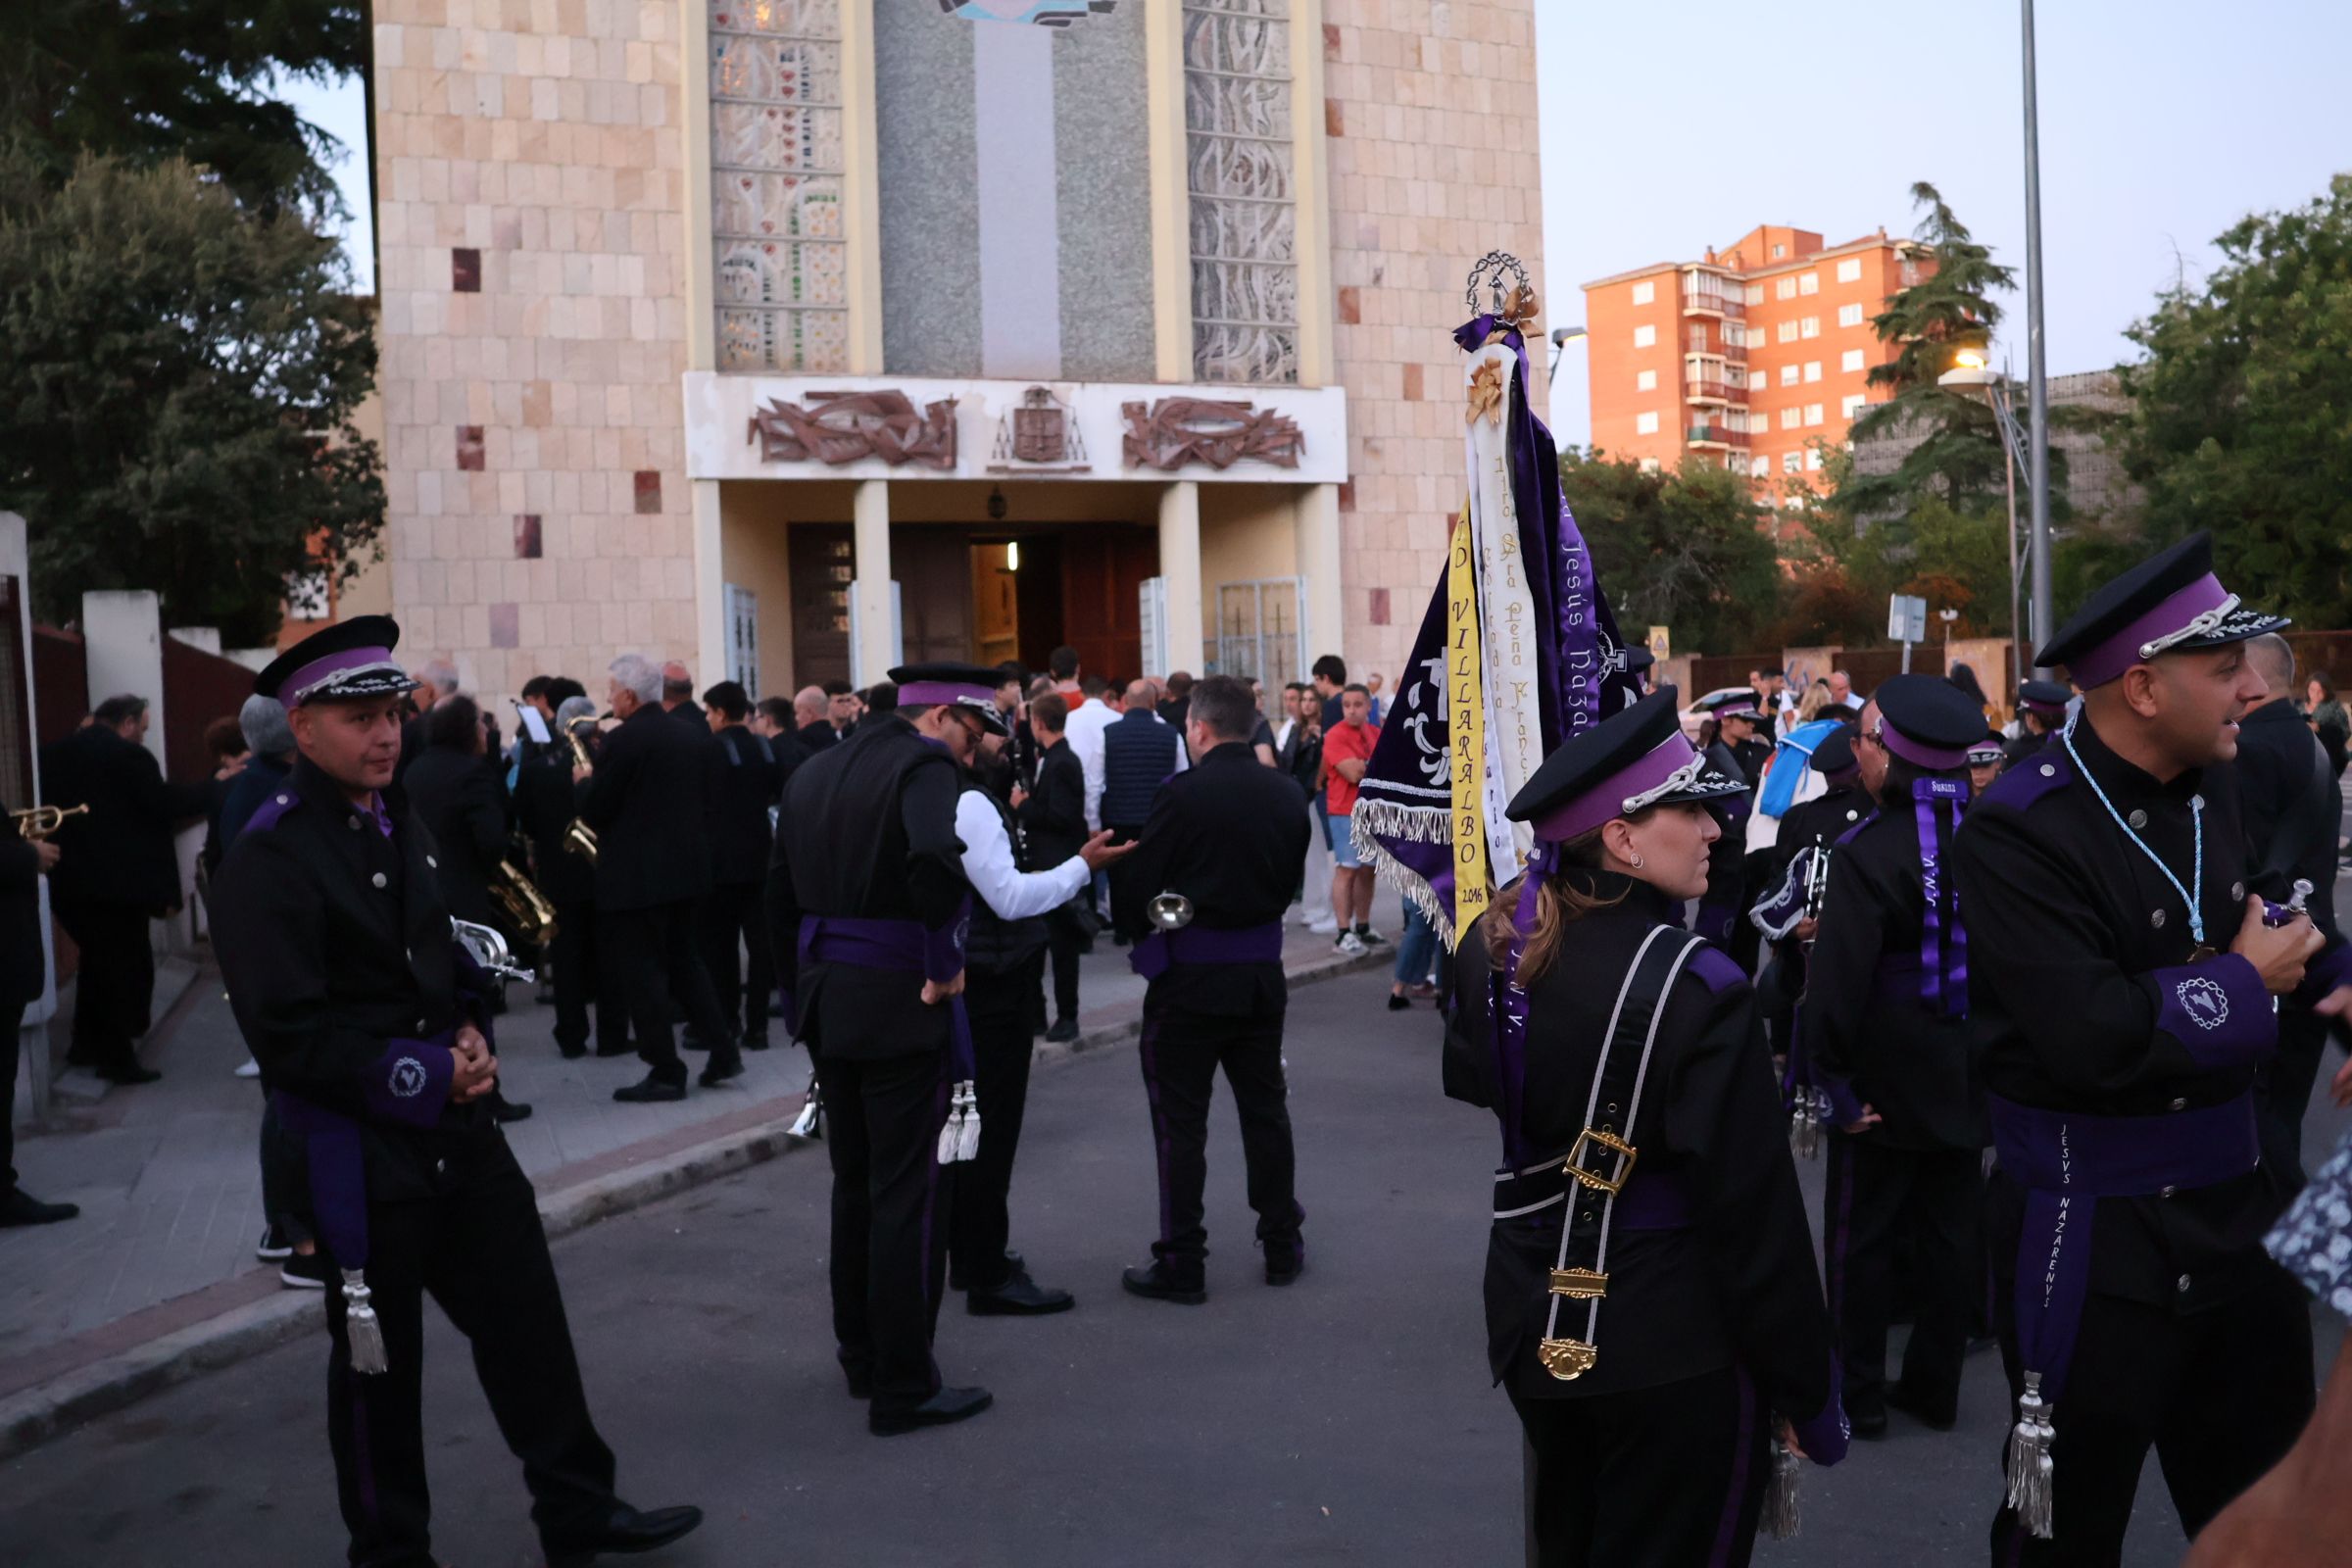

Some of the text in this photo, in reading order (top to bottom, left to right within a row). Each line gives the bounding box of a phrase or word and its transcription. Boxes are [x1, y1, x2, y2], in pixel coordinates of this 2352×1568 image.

[1561, 541, 1588, 626] Jesús
[1451, 598, 1477, 863] VILLARALBO
[1510, 681, 1529, 785] Franci
[1568, 649, 1592, 738] Naza
[1932, 780, 1956, 793] Susana
[1462, 887, 1483, 904] 2016
[2043, 1123, 2071, 1308] JESVS NAZARENVS
